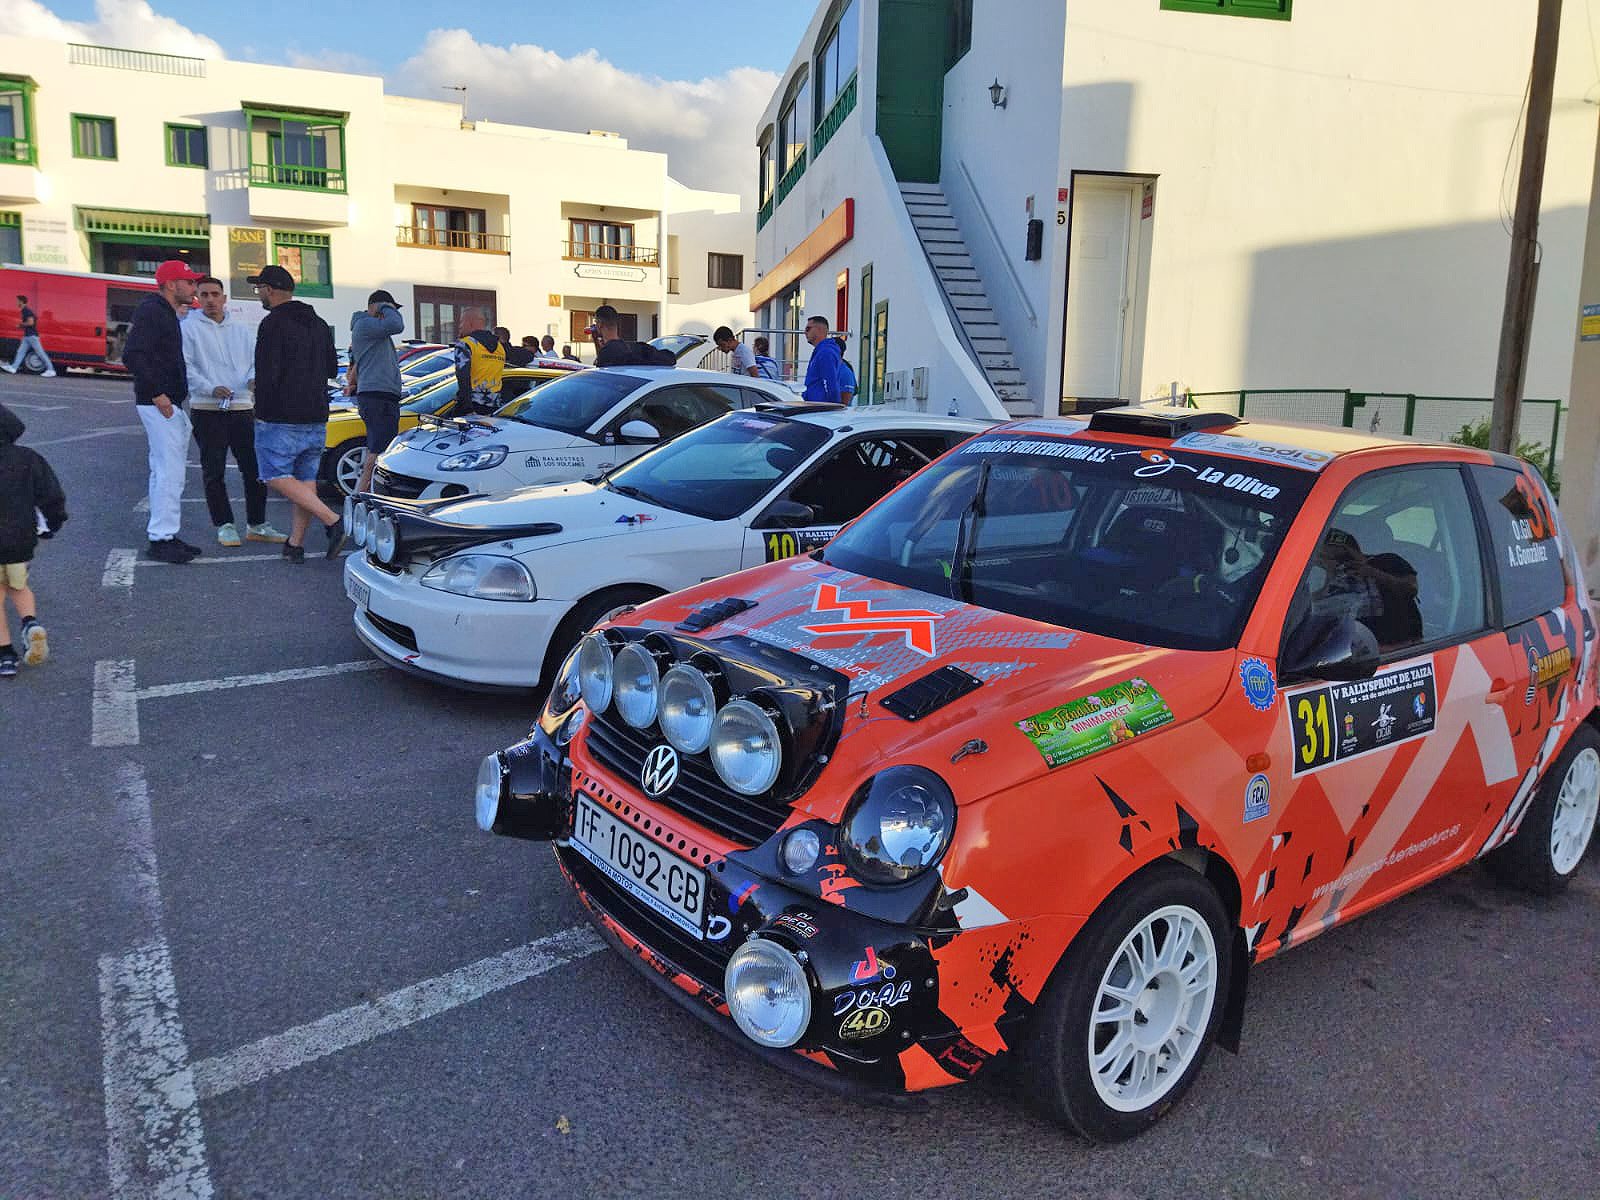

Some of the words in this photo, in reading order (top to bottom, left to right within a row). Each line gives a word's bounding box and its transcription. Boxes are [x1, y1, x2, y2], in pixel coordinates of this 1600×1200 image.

[1057, 211, 1066, 225] 5
[1197, 467, 1224, 484] La
[1223, 474, 1281, 500] Oliva
[1333, 689, 1340, 700] V
[1341, 676, 1399, 698] RALLYSPRINT
[1399, 671, 1410, 681] DE
[1410, 666, 1433, 680] YAIZA
[1071, 704, 1132, 733] MINIMARKET
[1298, 694, 1331, 764] 31
[848, 1010, 884, 1031] 40
